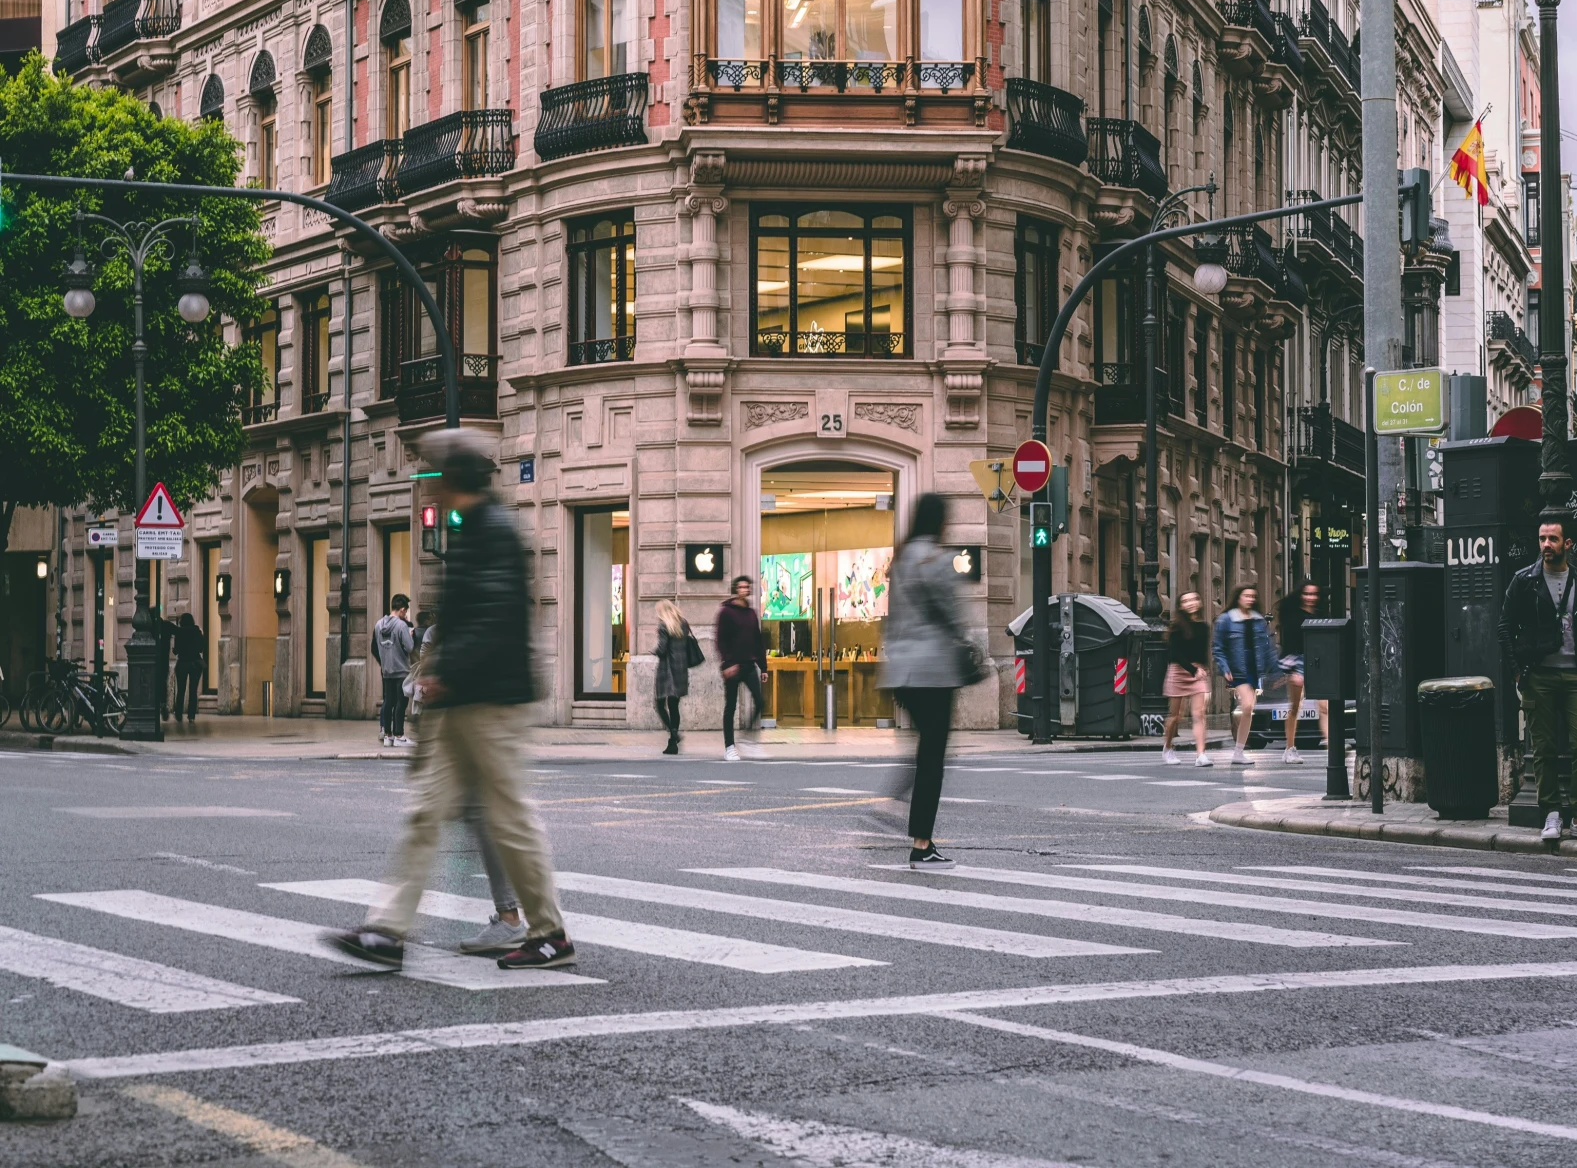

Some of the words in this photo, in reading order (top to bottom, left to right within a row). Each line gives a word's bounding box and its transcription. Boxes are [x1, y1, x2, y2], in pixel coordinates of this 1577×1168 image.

[1417, 378, 1430, 390] de
[1391, 399, 1423, 414] Colón
[821, 413, 843, 432] 25
[1300, 710, 1316, 719] JMD
